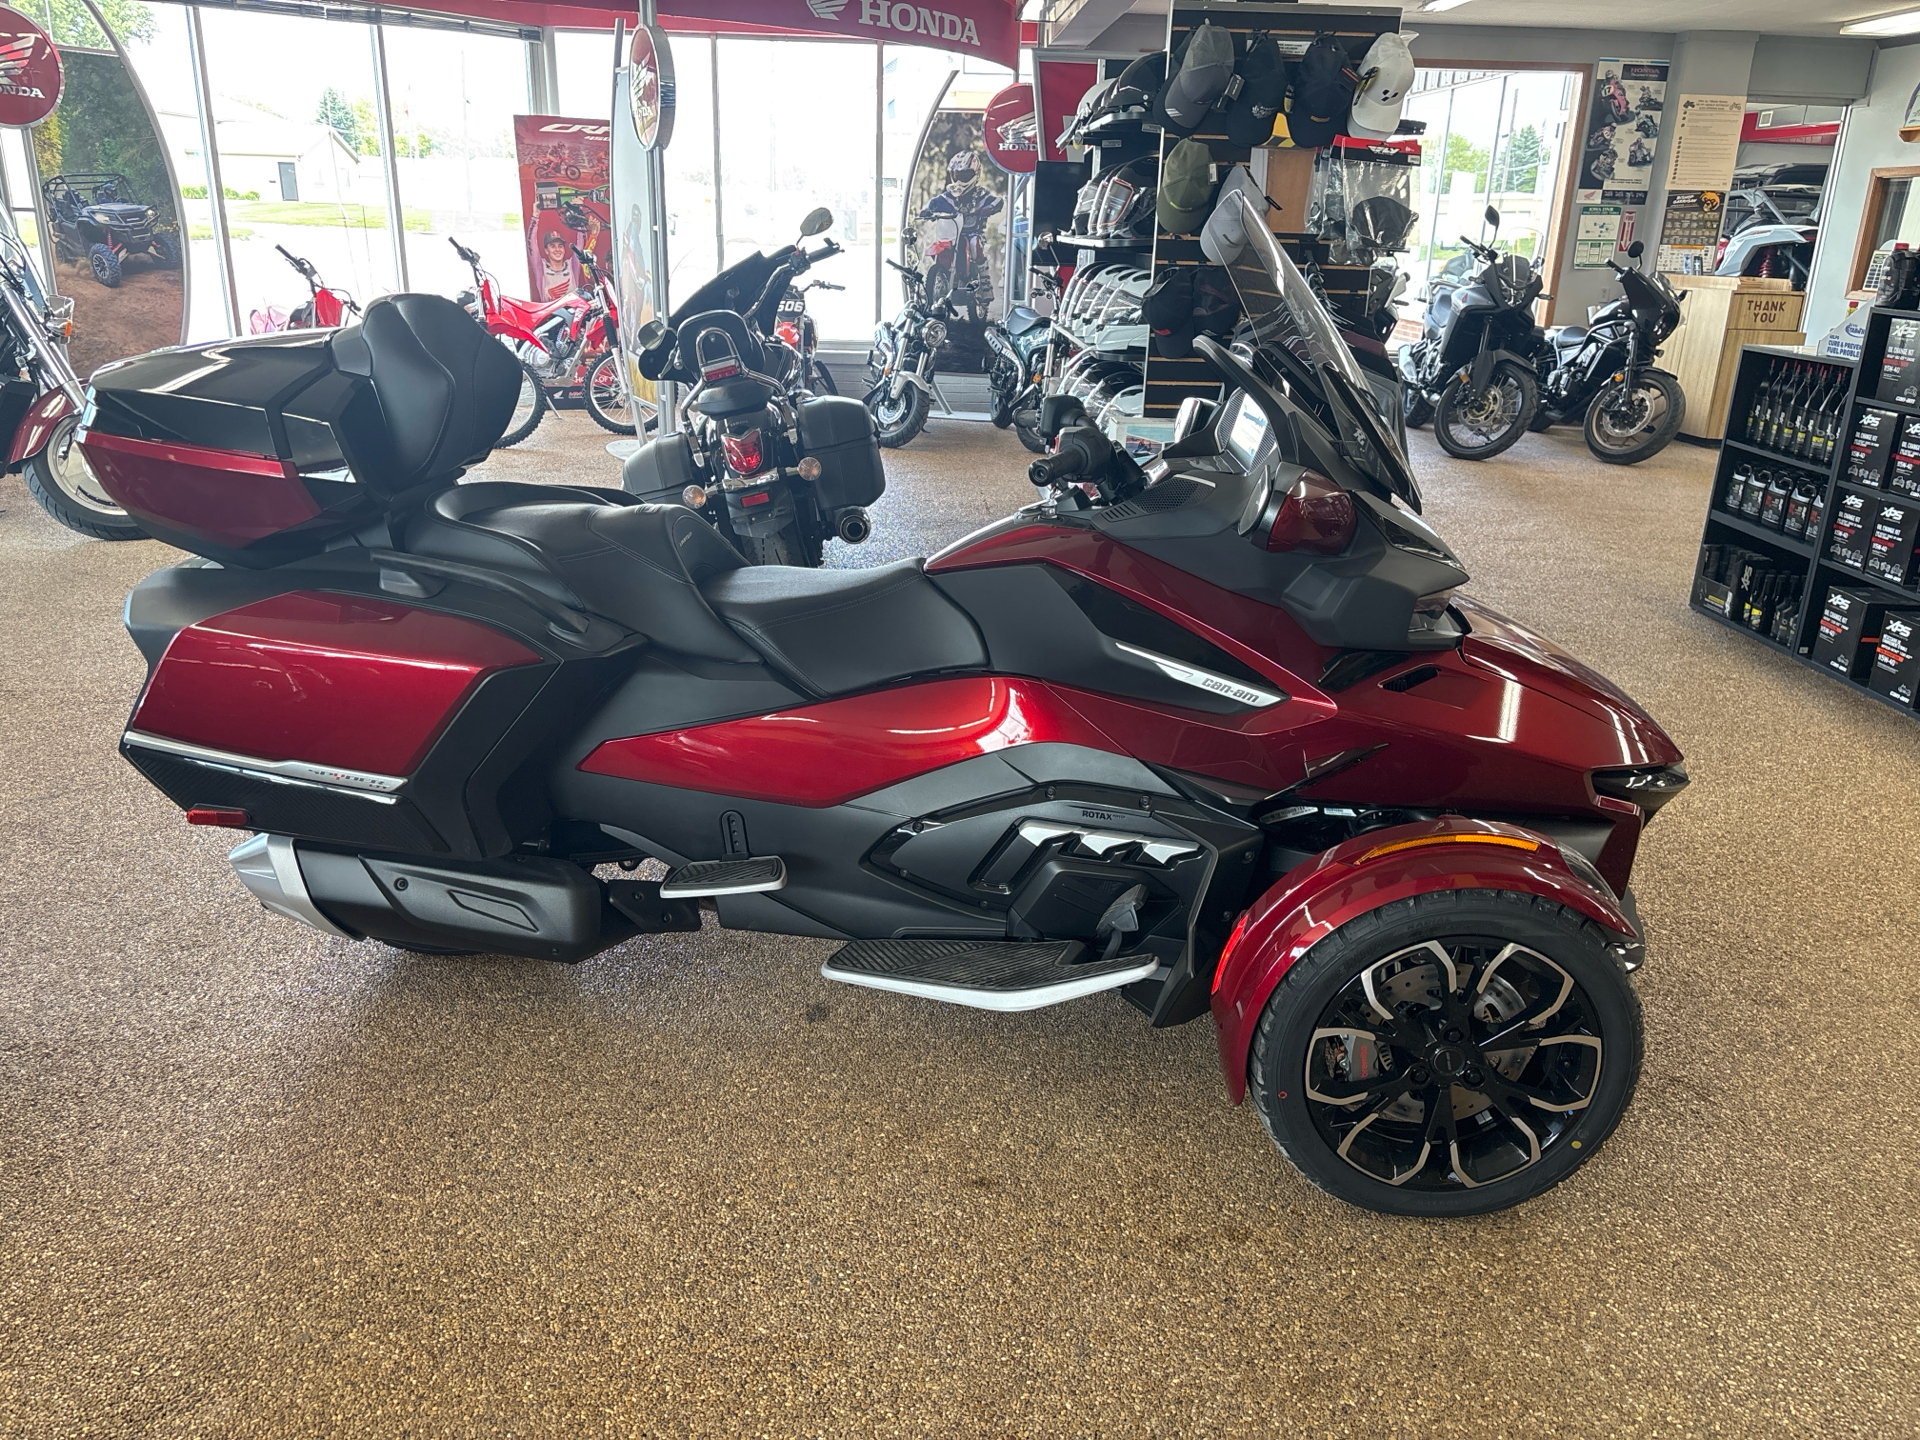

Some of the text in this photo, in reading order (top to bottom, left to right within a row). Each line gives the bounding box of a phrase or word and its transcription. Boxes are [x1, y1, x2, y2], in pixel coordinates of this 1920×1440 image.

[858, 0, 981, 46] HONDA
[0, 84, 45, 98] NDA
[998, 142, 1038, 151] HOND
[1747, 300, 1787, 312] THANK
[1753, 312, 1777, 323] YOU
[1892, 324, 1919, 338] XPS
[1827, 346, 1860, 358] FUEL PROBLE
[1858, 414, 1882, 427] XPS
[1905, 422, 1920, 436] XP
[1842, 494, 1865, 508] XPS
[1880, 506, 1904, 520] XPS
[1740, 564, 1753, 592] XPS
[1828, 594, 1852, 610] XPS
[1885, 620, 1912, 638] XPS
[1202, 677, 1259, 703] can-am
[1082, 810, 1113, 821] ROTAX
[1360, 1044, 1369, 1079] brembo
